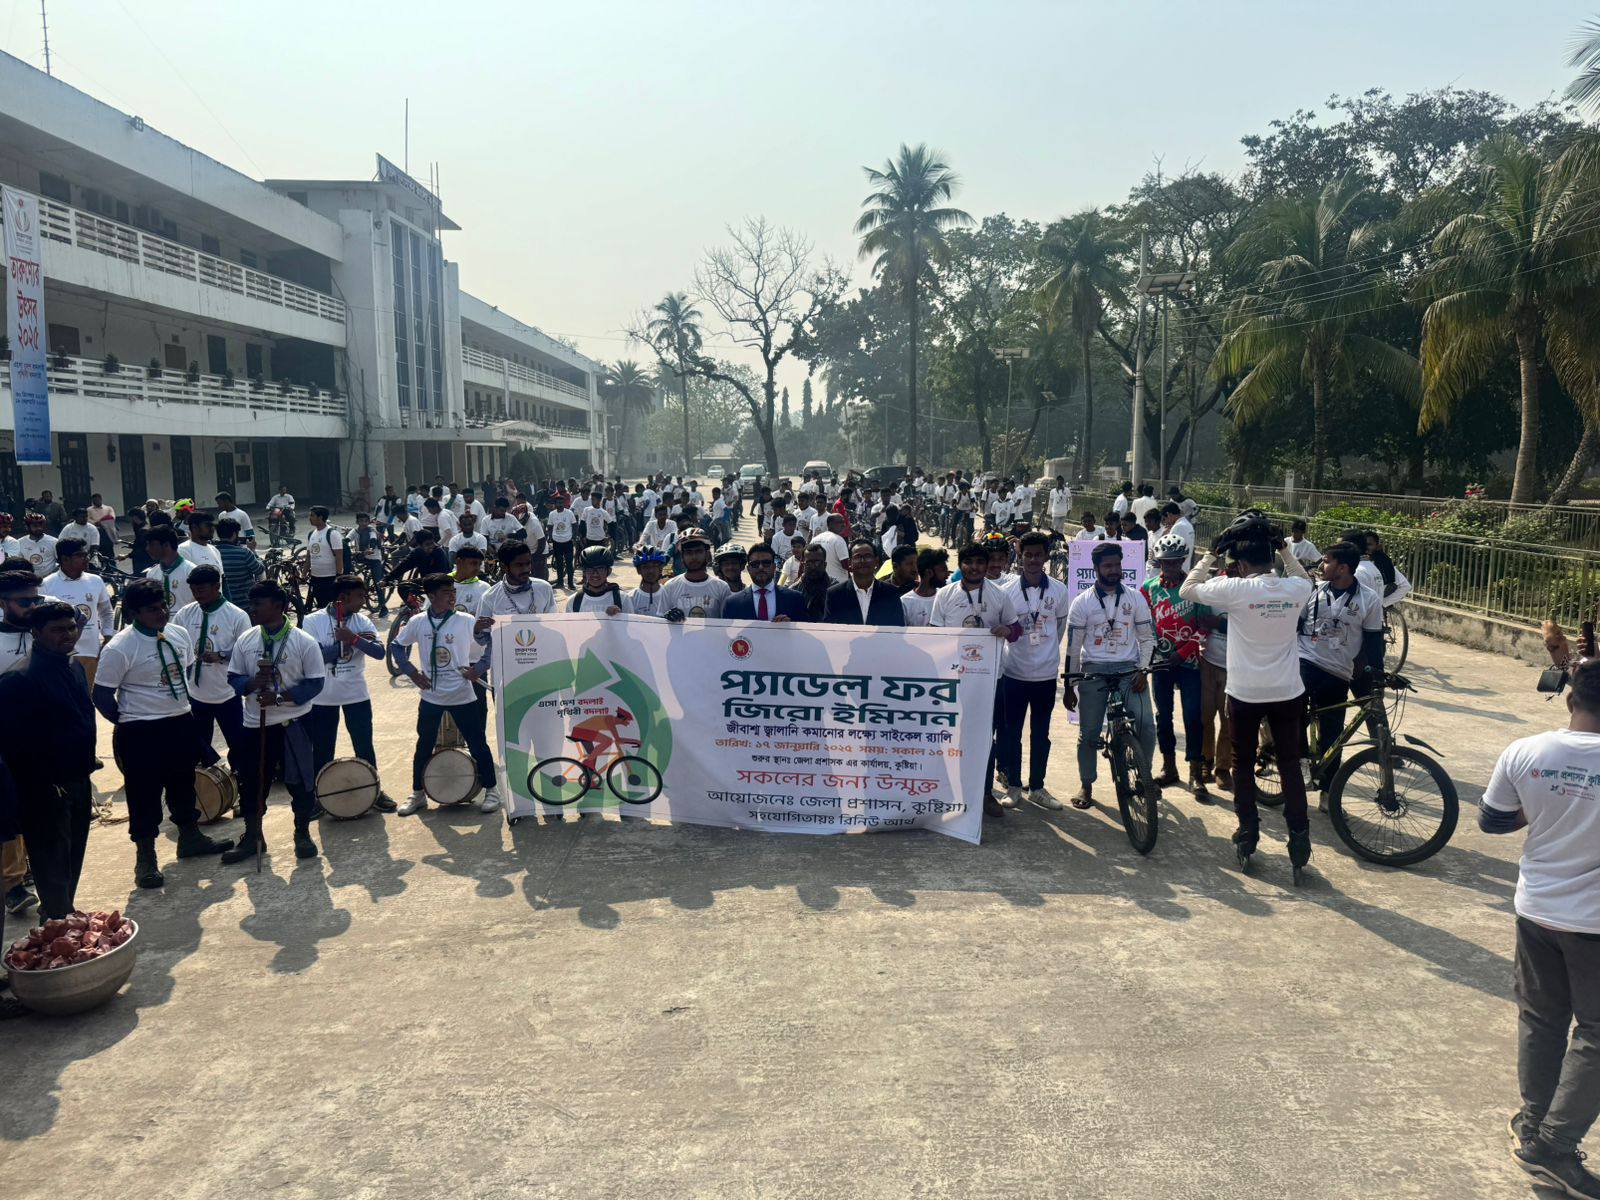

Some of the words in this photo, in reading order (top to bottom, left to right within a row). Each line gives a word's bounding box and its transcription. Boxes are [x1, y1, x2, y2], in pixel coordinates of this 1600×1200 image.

[720, 670, 872, 700] প্যাডেল
[881, 676, 961, 706] ফর
[538, 699, 557, 708] এসো
[557, 707, 581, 718] পৃথিবী
[722, 697, 824, 723] জিরো
[831, 702, 959, 727] ইমিশন
[726, 721, 761, 737] জীবাশ্ম
[764, 722, 798, 737] জ্বালানি
[803, 726, 845, 739] কমানোর
[848, 727, 876, 741] লক্ষ্যে
[879, 727, 922, 743] সাইকেল
[755, 741, 771, 749] ১৭
[774, 739, 820, 752] জানুয়ারি
[823, 743, 853, 753] ২০২৫
[892, 746, 926, 756] সকাল
[928, 749, 944, 757] ১০
[793, 757, 813, 765] জেলা
[814, 757, 844, 767] প্রশাসক
[846, 759, 858, 767] এর
[736, 769, 817, 787] সকলের
[822, 773, 870, 790] জন্য
[875, 774, 940, 796] উন্মুক্ত
[800, 794, 842, 809] জেলা
[847, 796, 906, 814] প্রশাসন,
[839, 813, 880, 828] রিনিউ
